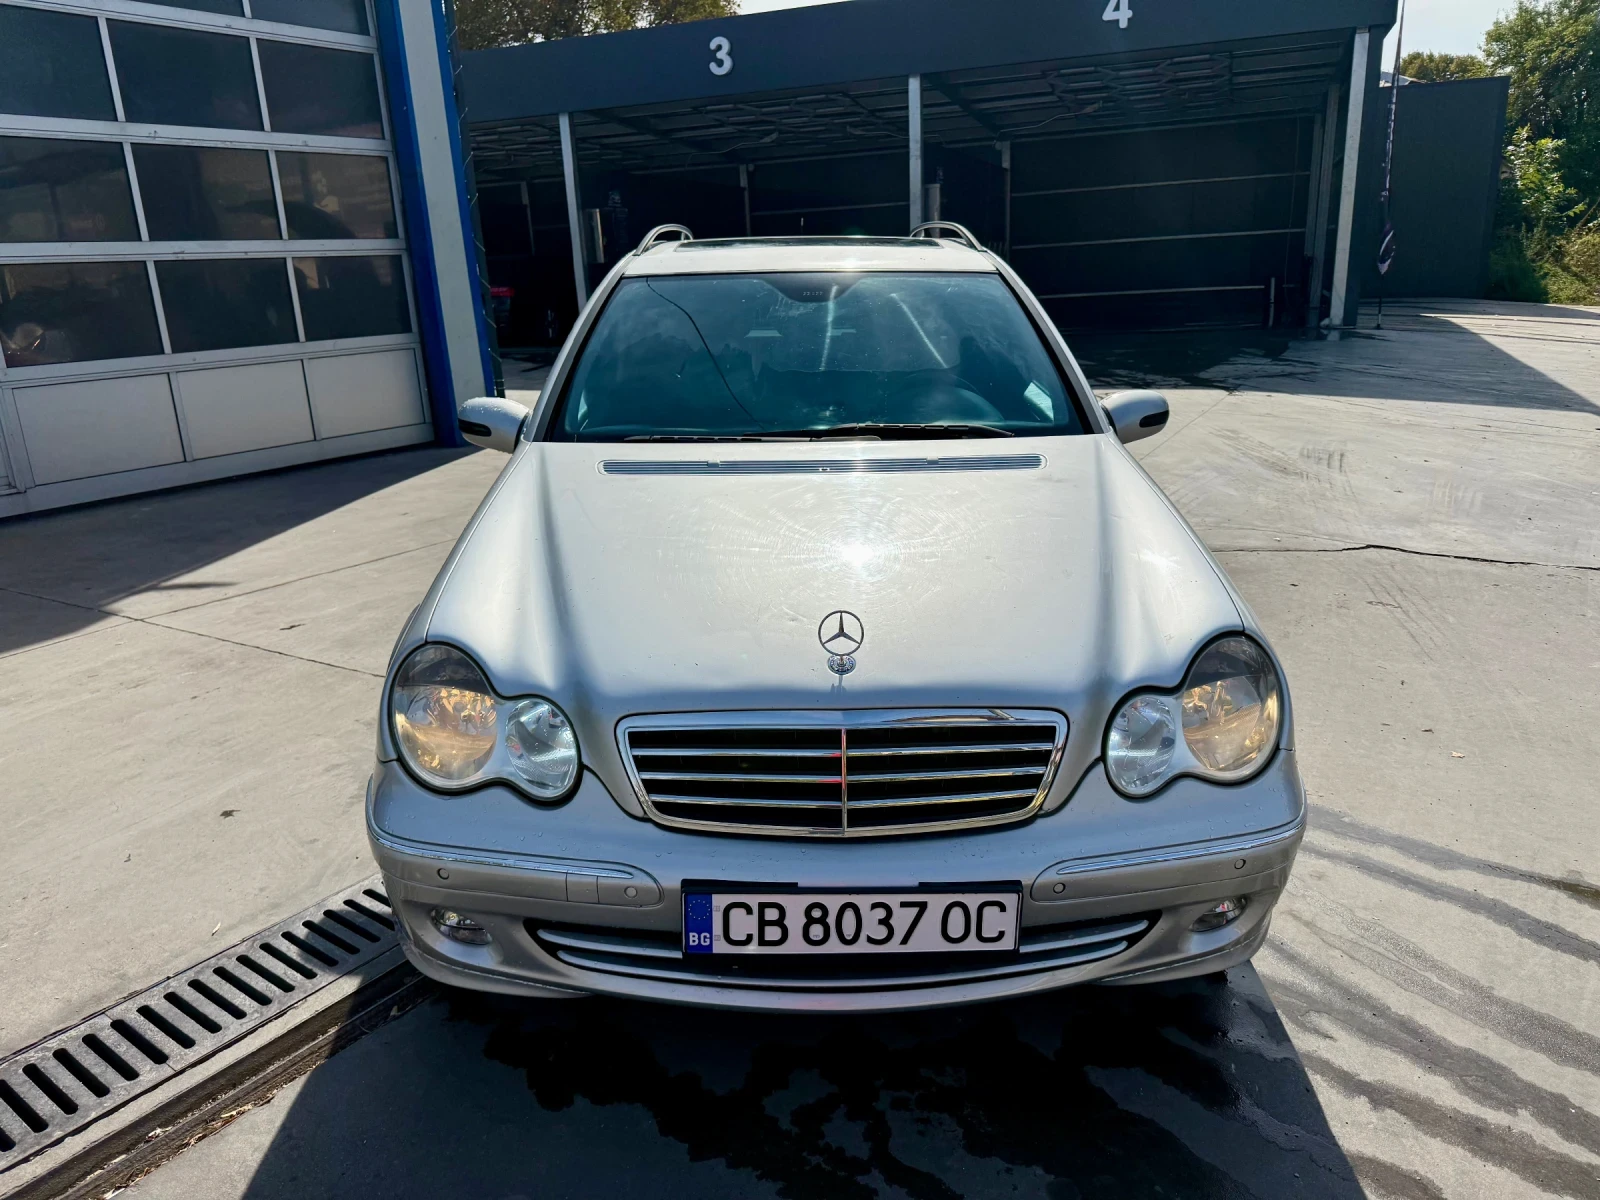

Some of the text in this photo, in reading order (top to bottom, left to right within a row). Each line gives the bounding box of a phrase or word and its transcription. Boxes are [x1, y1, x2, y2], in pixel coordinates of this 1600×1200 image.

[1102, 0, 1133, 29] 4
[709, 36, 733, 76] 3
[688, 932, 711, 946] BG
[722, 900, 1007, 947] CB 8037 OC
